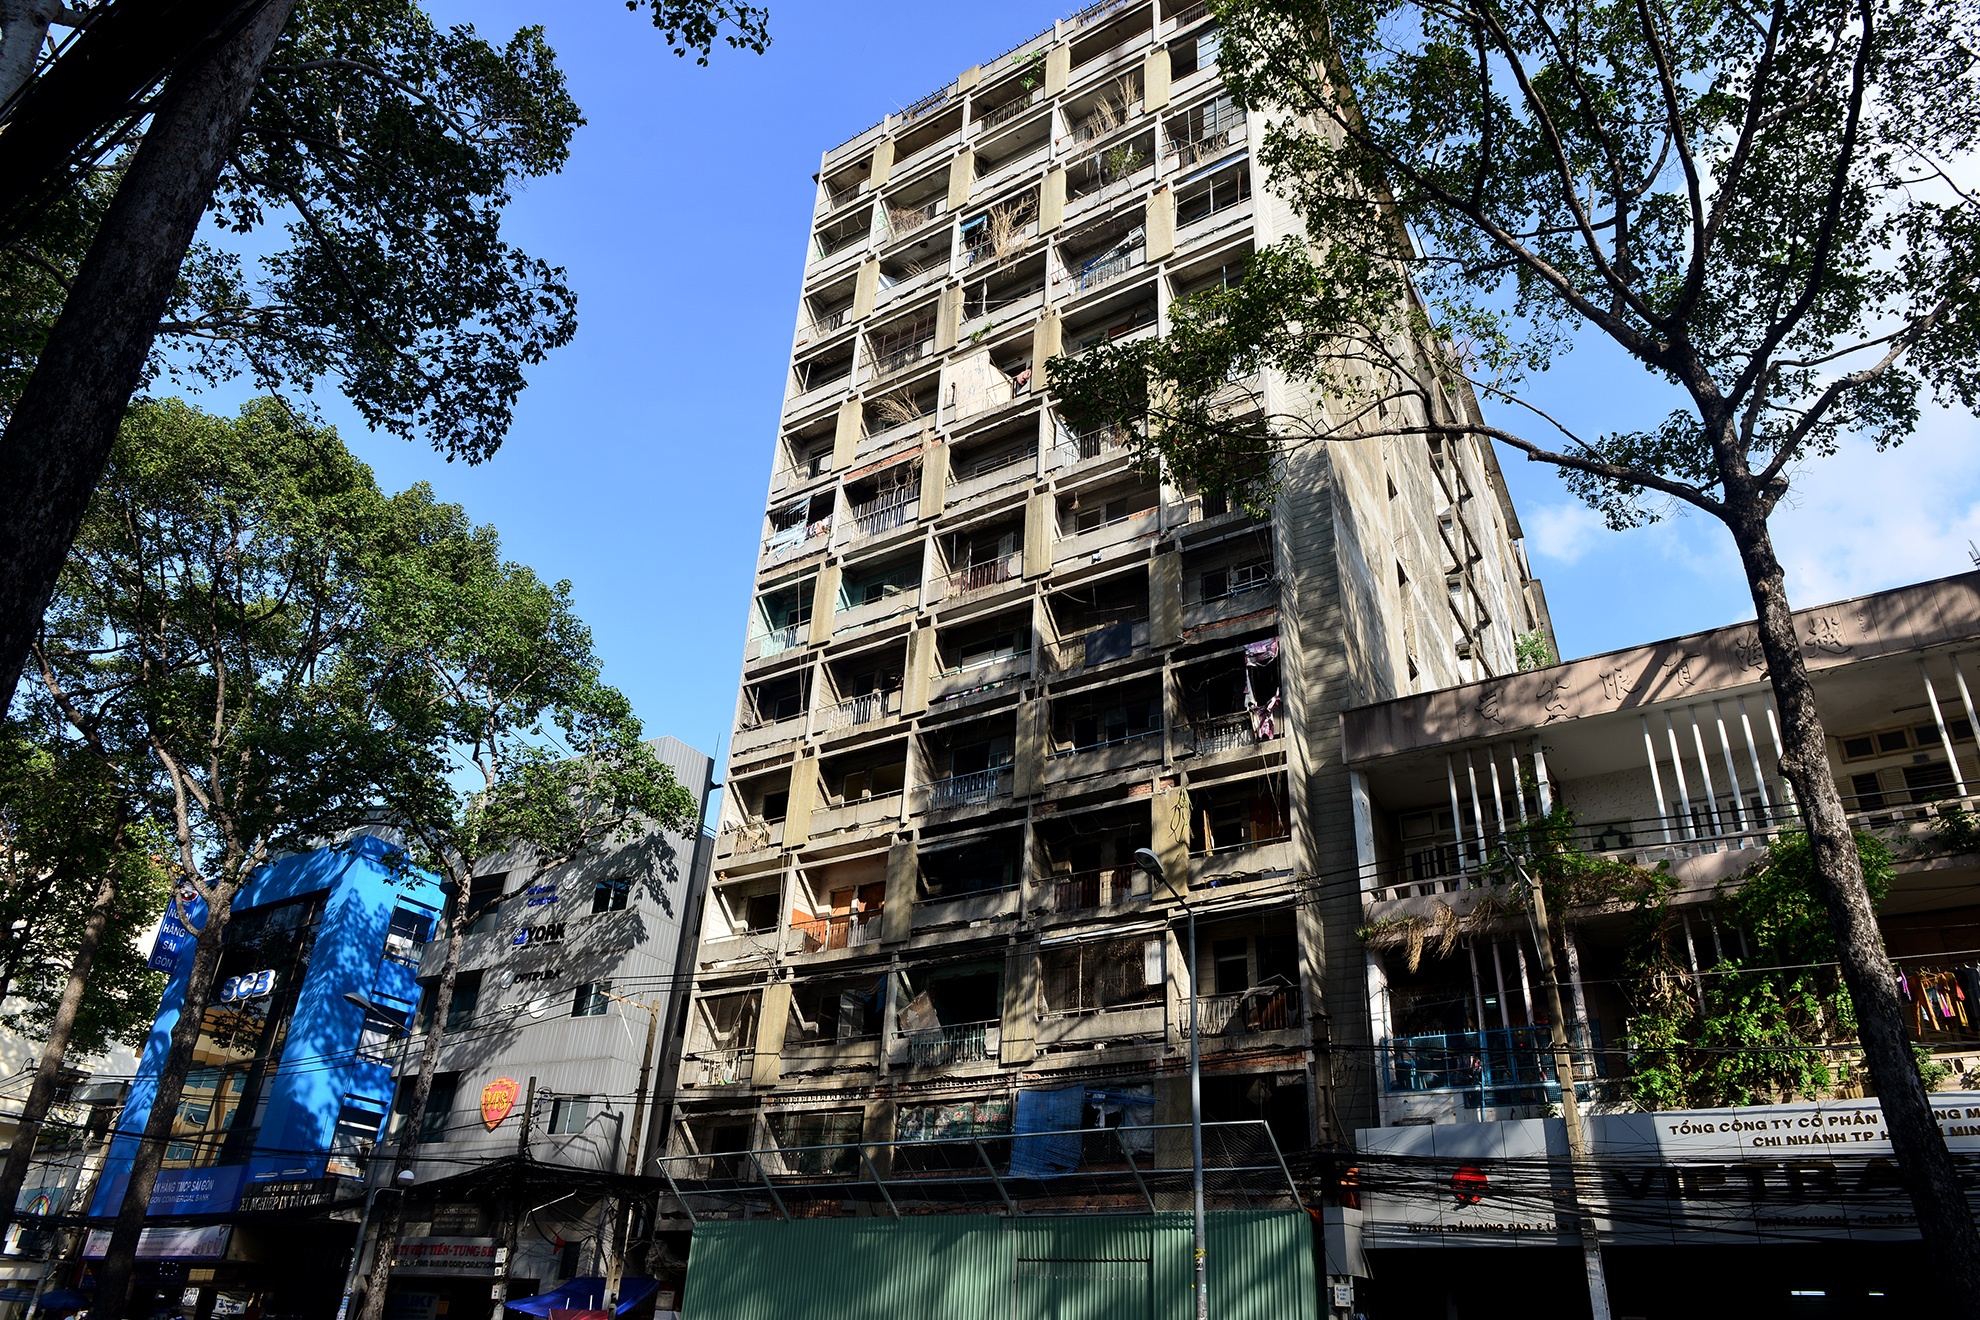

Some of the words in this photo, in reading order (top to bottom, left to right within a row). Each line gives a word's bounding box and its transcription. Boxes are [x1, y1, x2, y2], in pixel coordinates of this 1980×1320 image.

[162, 922, 185, 938] HÀNG
[528, 922, 567, 943] YORK
[162, 939, 177, 952] SÀI
[154, 953, 173, 968] GÒN
[220, 969, 274, 1002] SCB
[1669, 1119, 1716, 1135] TỔNG
[1719, 1119, 1768, 1133] CÔNG
[1770, 1118, 1793, 1130] TY
[1797, 1111, 1823, 1128] CỔ
[1828, 1110, 1878, 1127] PHẦN
[1752, 1136, 1780, 1148] CHI
[1785, 1130, 1846, 1146] NHÁNH
[1850, 1130, 1875, 1141] TP
[191, 1178, 201, 1191] SÀI
[201, 1177, 215, 1191] GÒN
